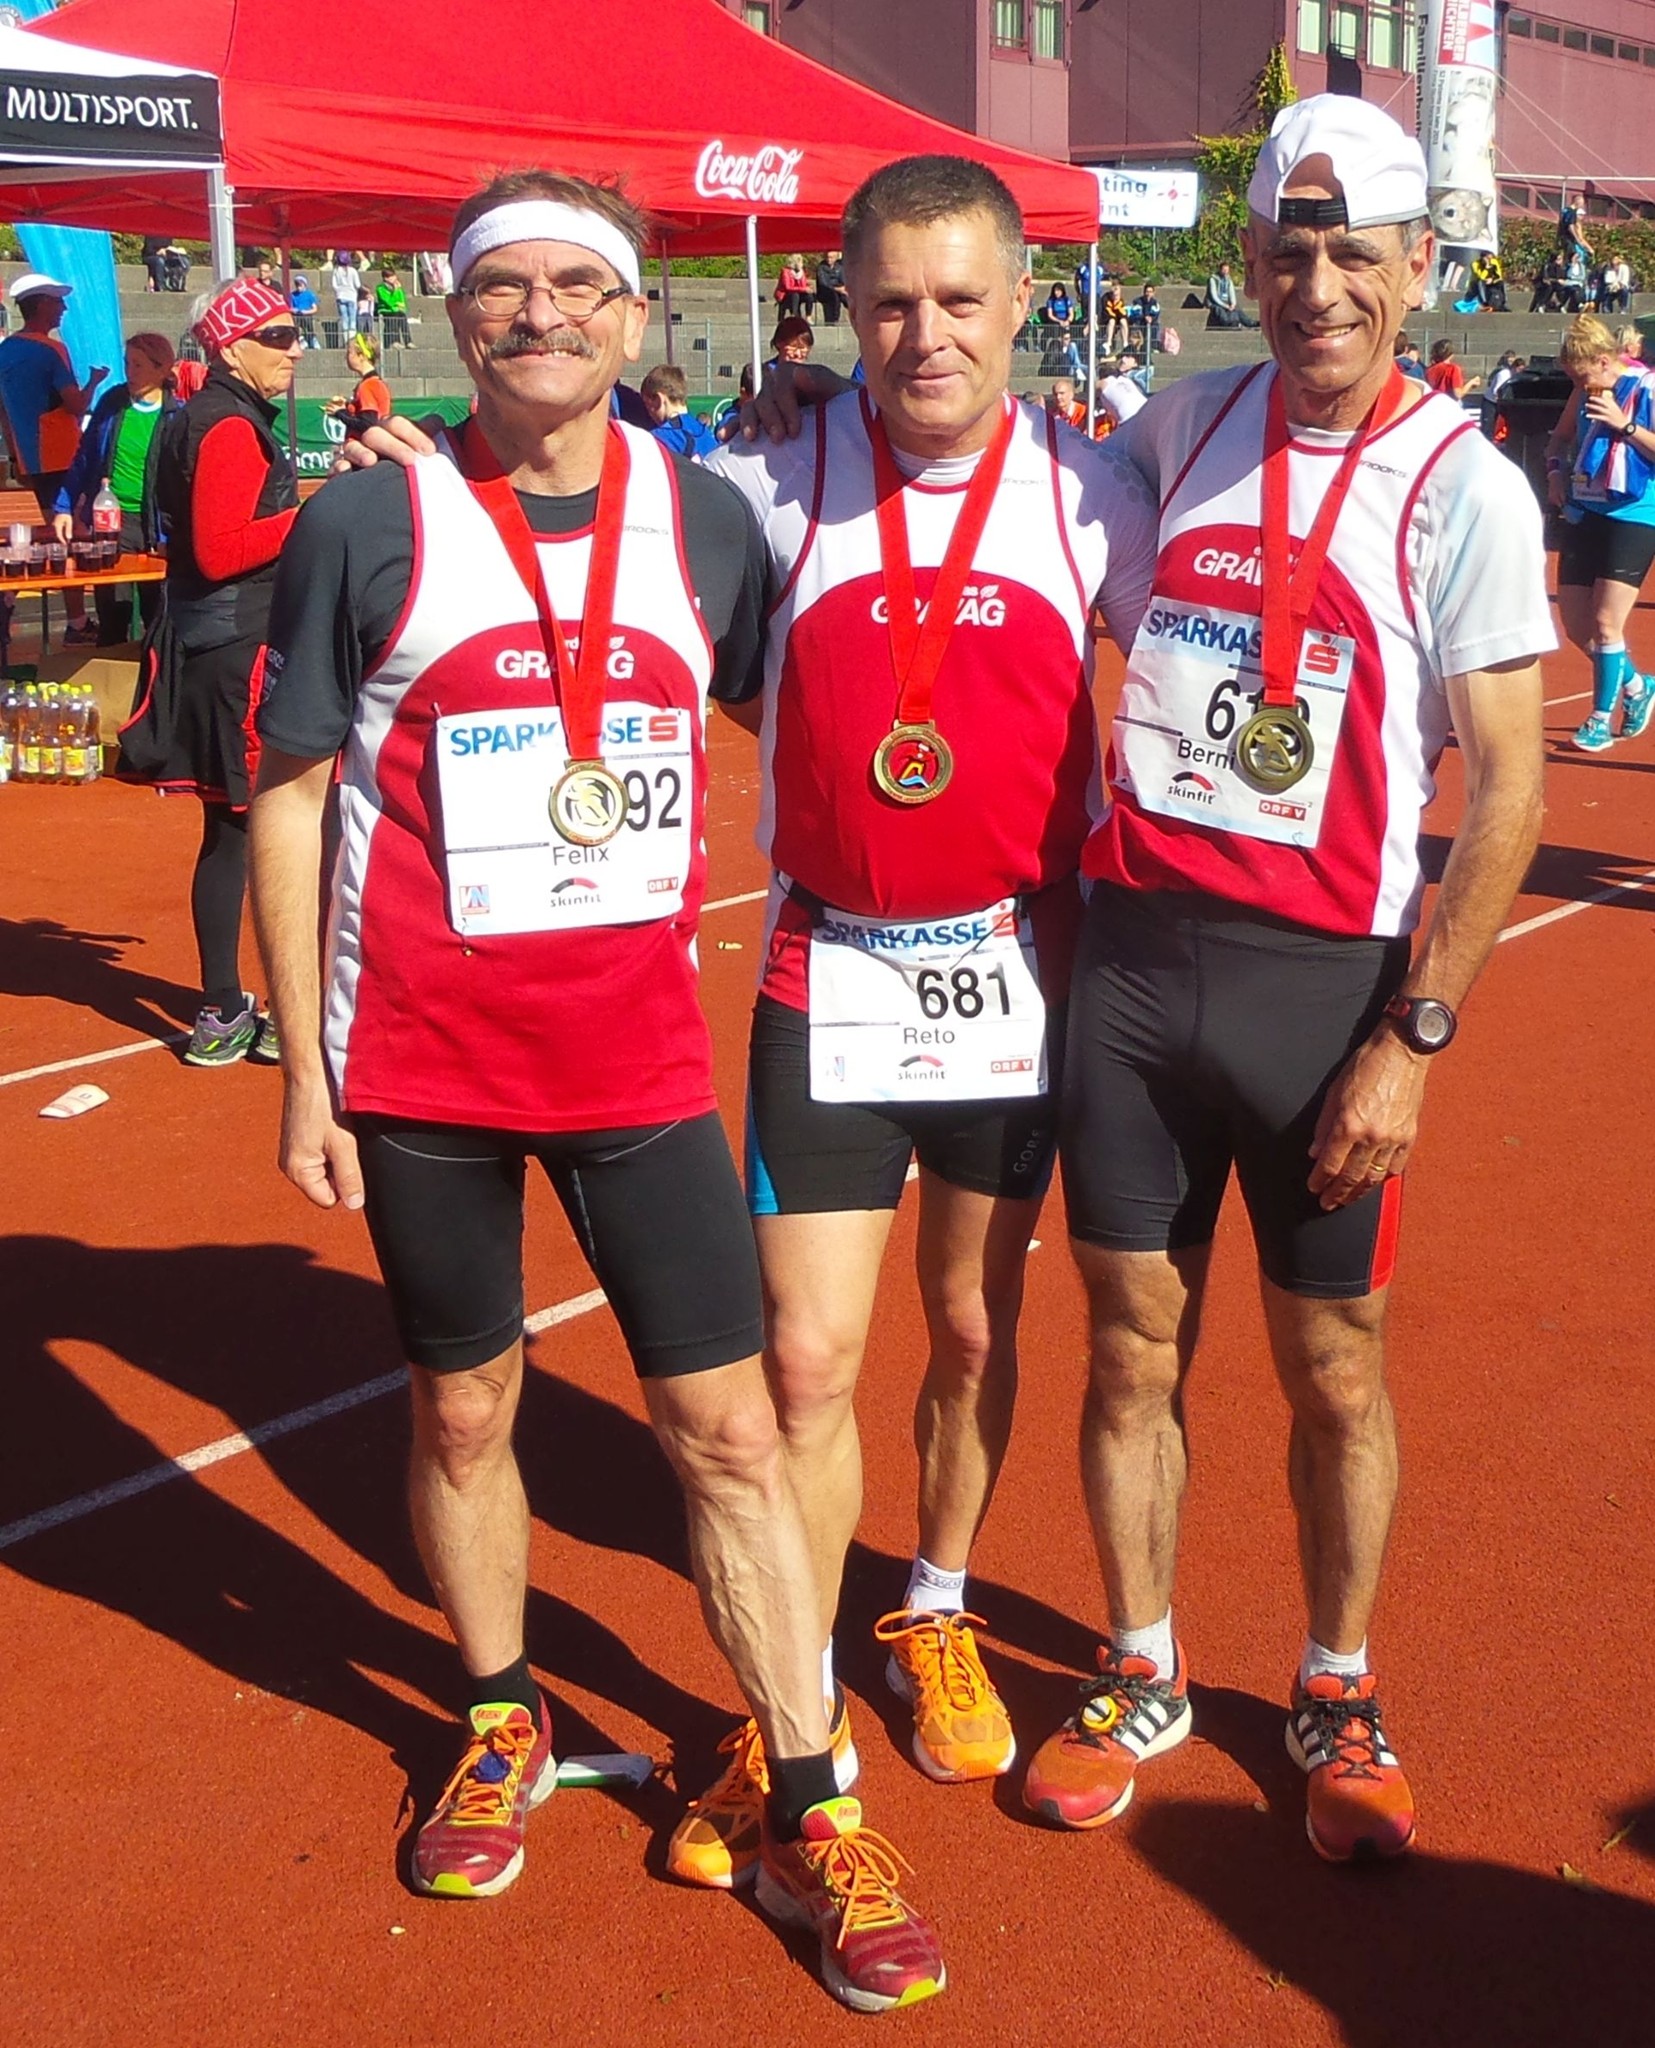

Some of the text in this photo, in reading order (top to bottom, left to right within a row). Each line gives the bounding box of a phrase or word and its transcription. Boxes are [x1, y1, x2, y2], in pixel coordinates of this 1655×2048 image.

[7, 87, 199, 130] MULTISPORT.
[1147, 609, 1263, 659] SPARKAS
[1177, 738, 1237, 772] Berni
[1166, 785, 1214, 805] skinfit
[552, 843, 609, 867] Felix
[917, 961, 1011, 1020] 681
[903, 1027, 956, 1045] Reto
